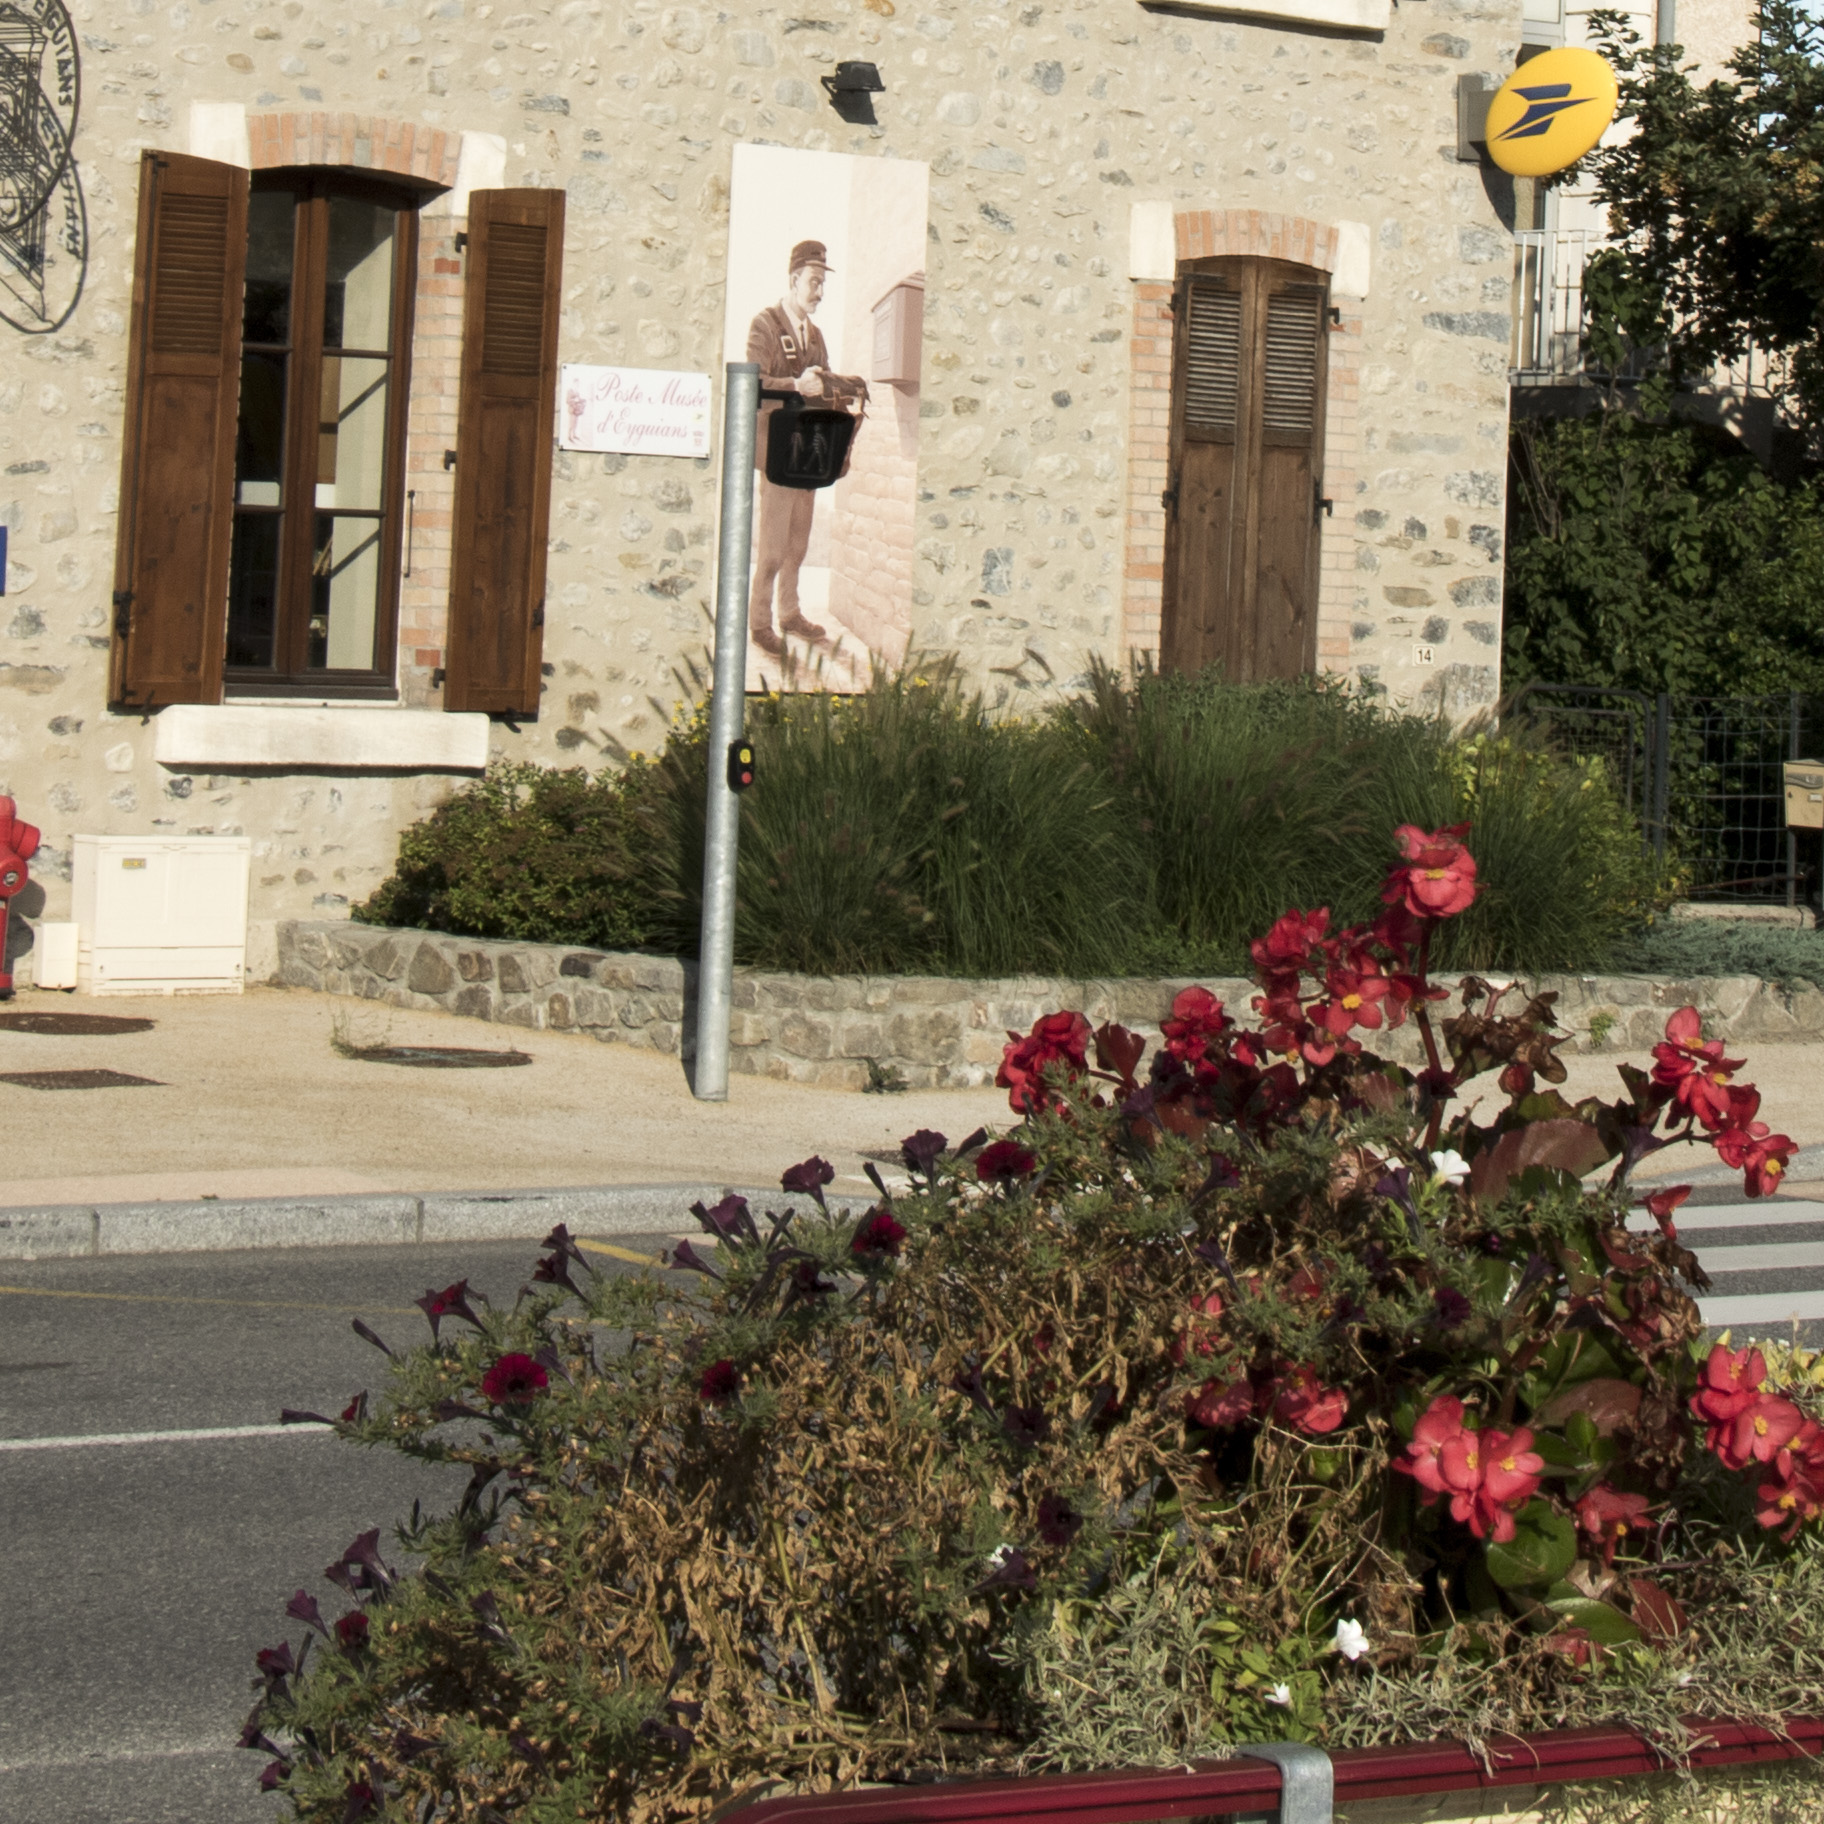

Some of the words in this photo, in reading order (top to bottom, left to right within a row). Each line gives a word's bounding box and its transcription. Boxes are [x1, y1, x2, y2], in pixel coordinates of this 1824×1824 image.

[596, 373, 644, 404] Poste
[648, 378, 707, 408] Musée
[597, 407, 688, 447] d'Eyguians
[1418, 648, 1431, 663] 14
